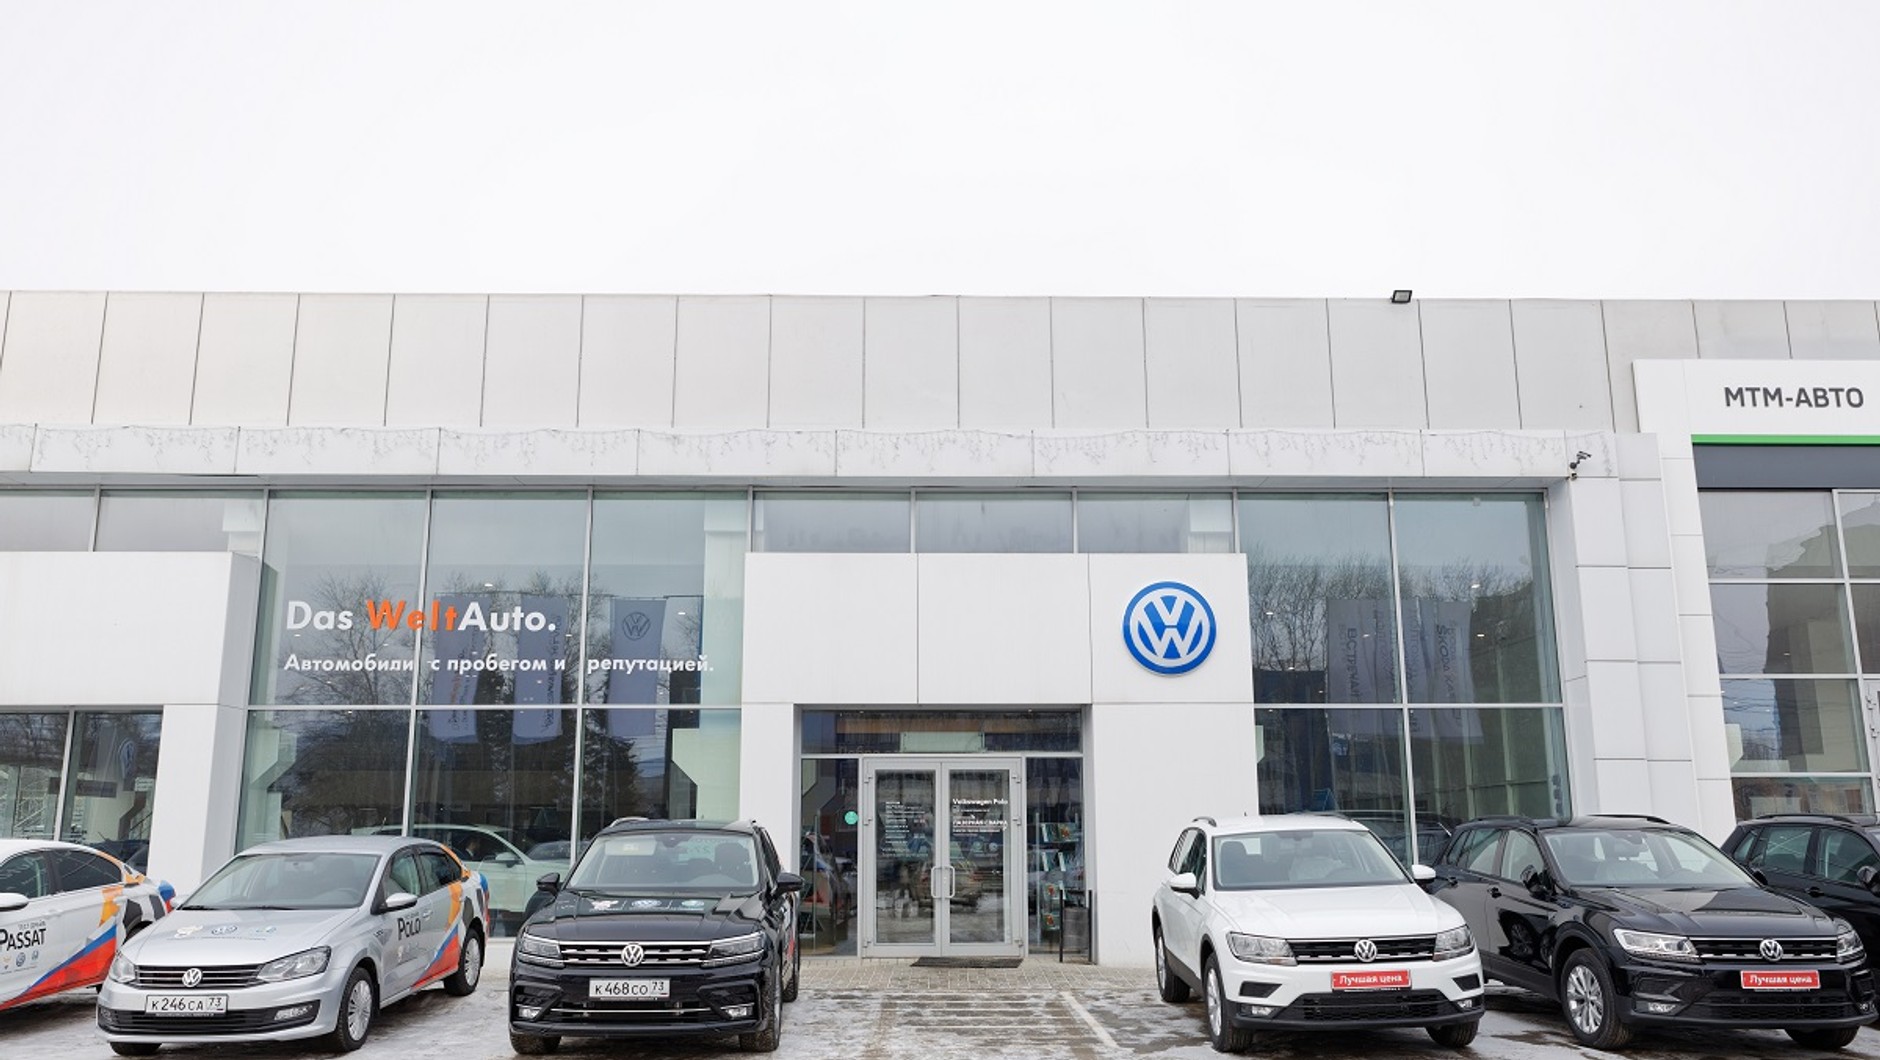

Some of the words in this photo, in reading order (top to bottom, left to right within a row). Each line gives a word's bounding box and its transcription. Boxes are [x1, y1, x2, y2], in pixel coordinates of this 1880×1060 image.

[1724, 387, 1865, 409] МТМ-АВТО
[286, 600, 354, 631] Das
[431, 659, 440, 671] с
[447, 653, 547, 675] пробегом
[555, 659, 566, 671] и
[587, 654, 714, 675] репутацией.
[1339, 975, 1378, 986] Лучшая
[1379, 975, 1402, 984] цена
[1749, 974, 1787, 985] Лучшая
[1788, 976, 1812, 984] цена
